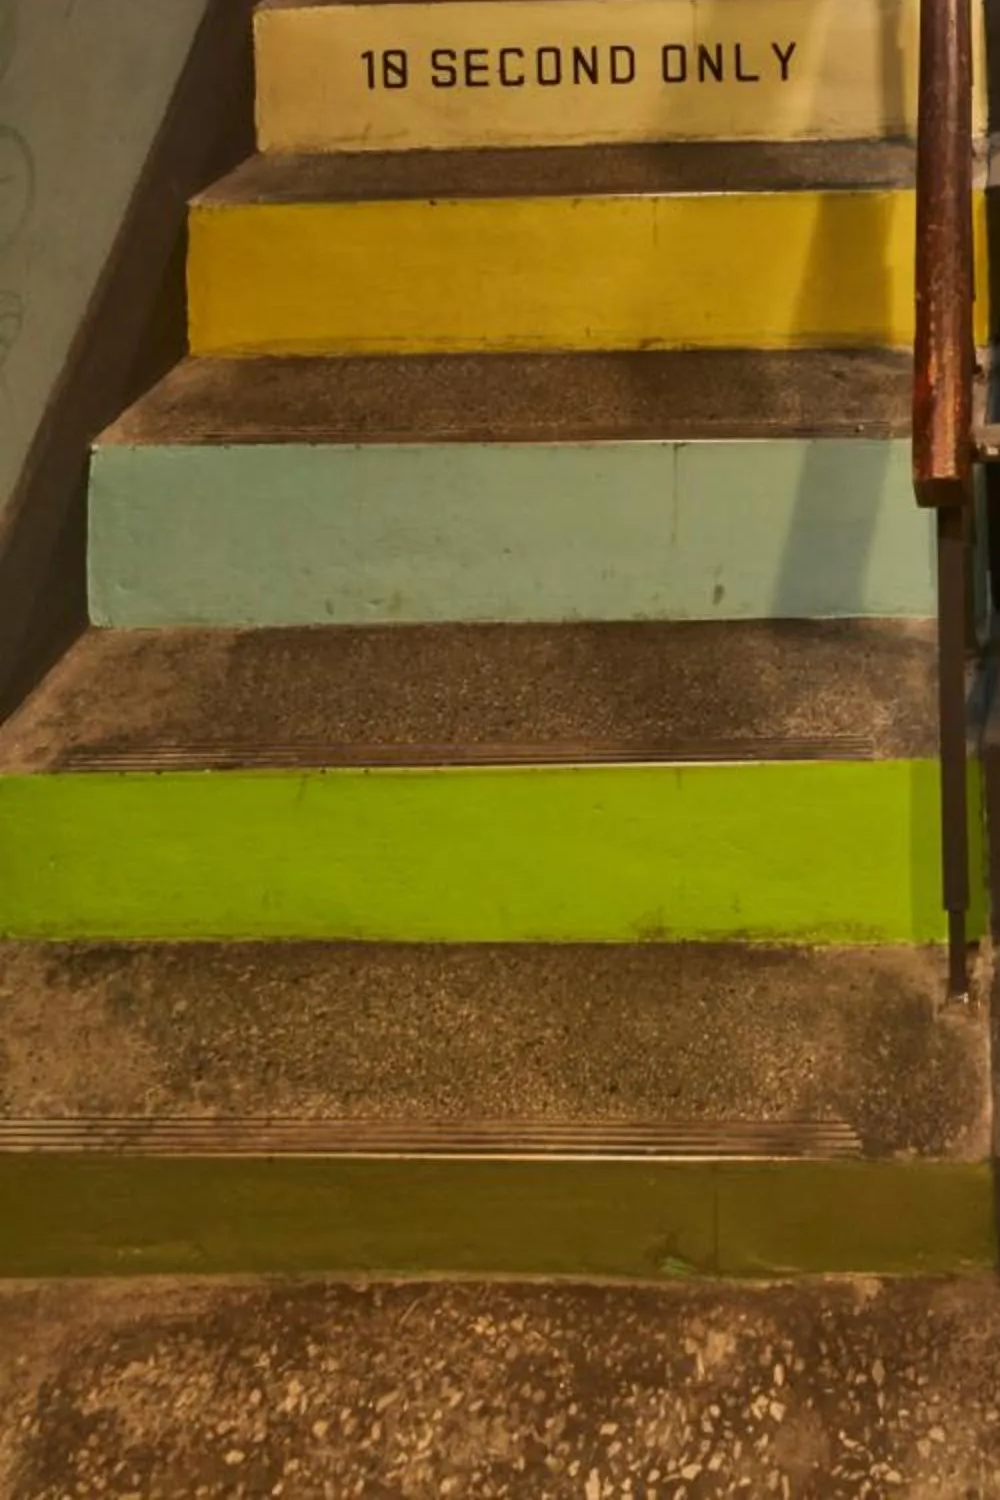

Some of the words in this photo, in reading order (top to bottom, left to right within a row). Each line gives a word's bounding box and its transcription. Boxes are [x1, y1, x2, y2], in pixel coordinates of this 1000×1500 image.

[360, 48, 409, 91] 10
[430, 44, 636, 89] SECOND
[661, 41, 798, 84] ONLY
